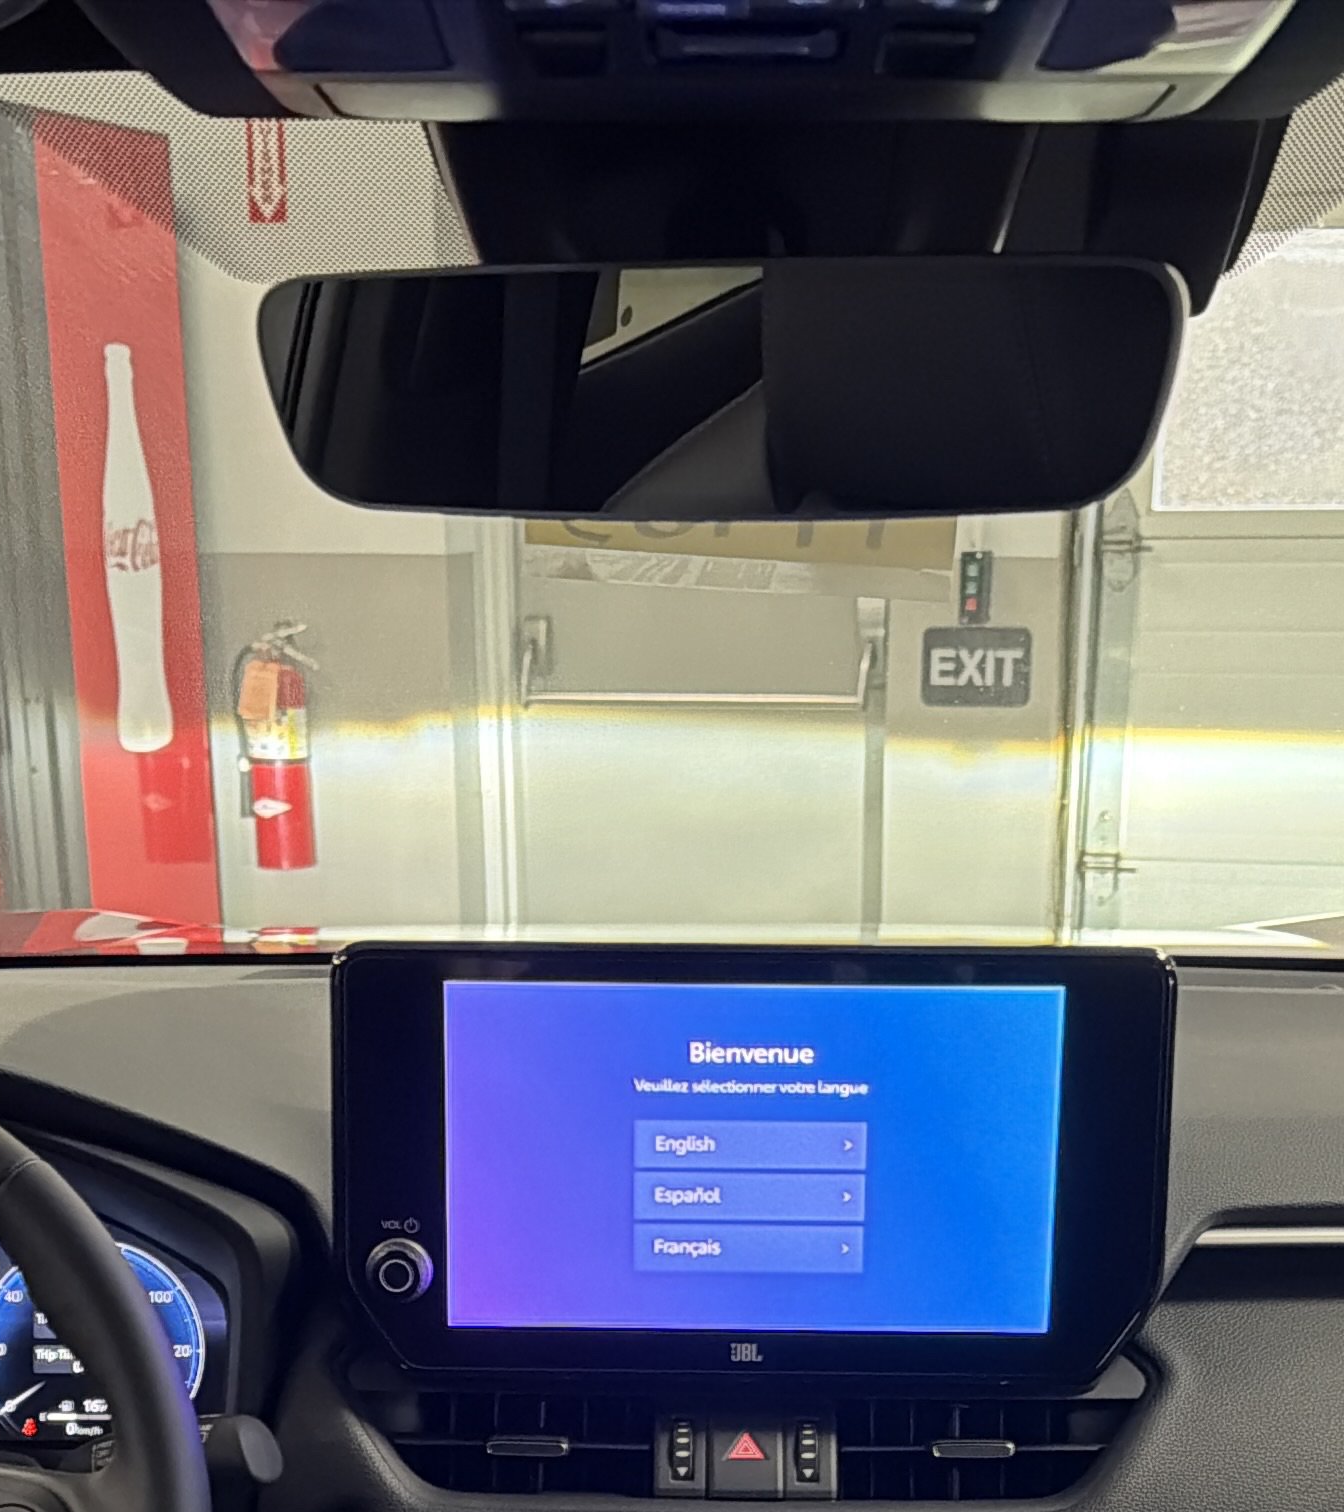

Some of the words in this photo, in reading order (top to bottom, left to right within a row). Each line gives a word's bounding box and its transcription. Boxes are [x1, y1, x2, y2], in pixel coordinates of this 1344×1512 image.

[928, 648, 1025, 687] EXIT
[688, 1041, 814, 1065] Bienvenue
[633, 1078, 689, 1094] Veuillez
[692, 1079, 777, 1095] sélectionner
[778, 1082, 816, 1095] votre
[817, 1080, 869, 1098] langue
[655, 1135, 716, 1157] English
[654, 1185, 721, 1207] Español
[380, 1218, 402, 1230] VOL
[653, 1238, 722, 1260] Français
[4, 1289, 23, 1303] 40
[148, 1290, 173, 1304] 100
[172, 1344, 191, 1358] 20
[730, 1343, 763, 1362] JBL
